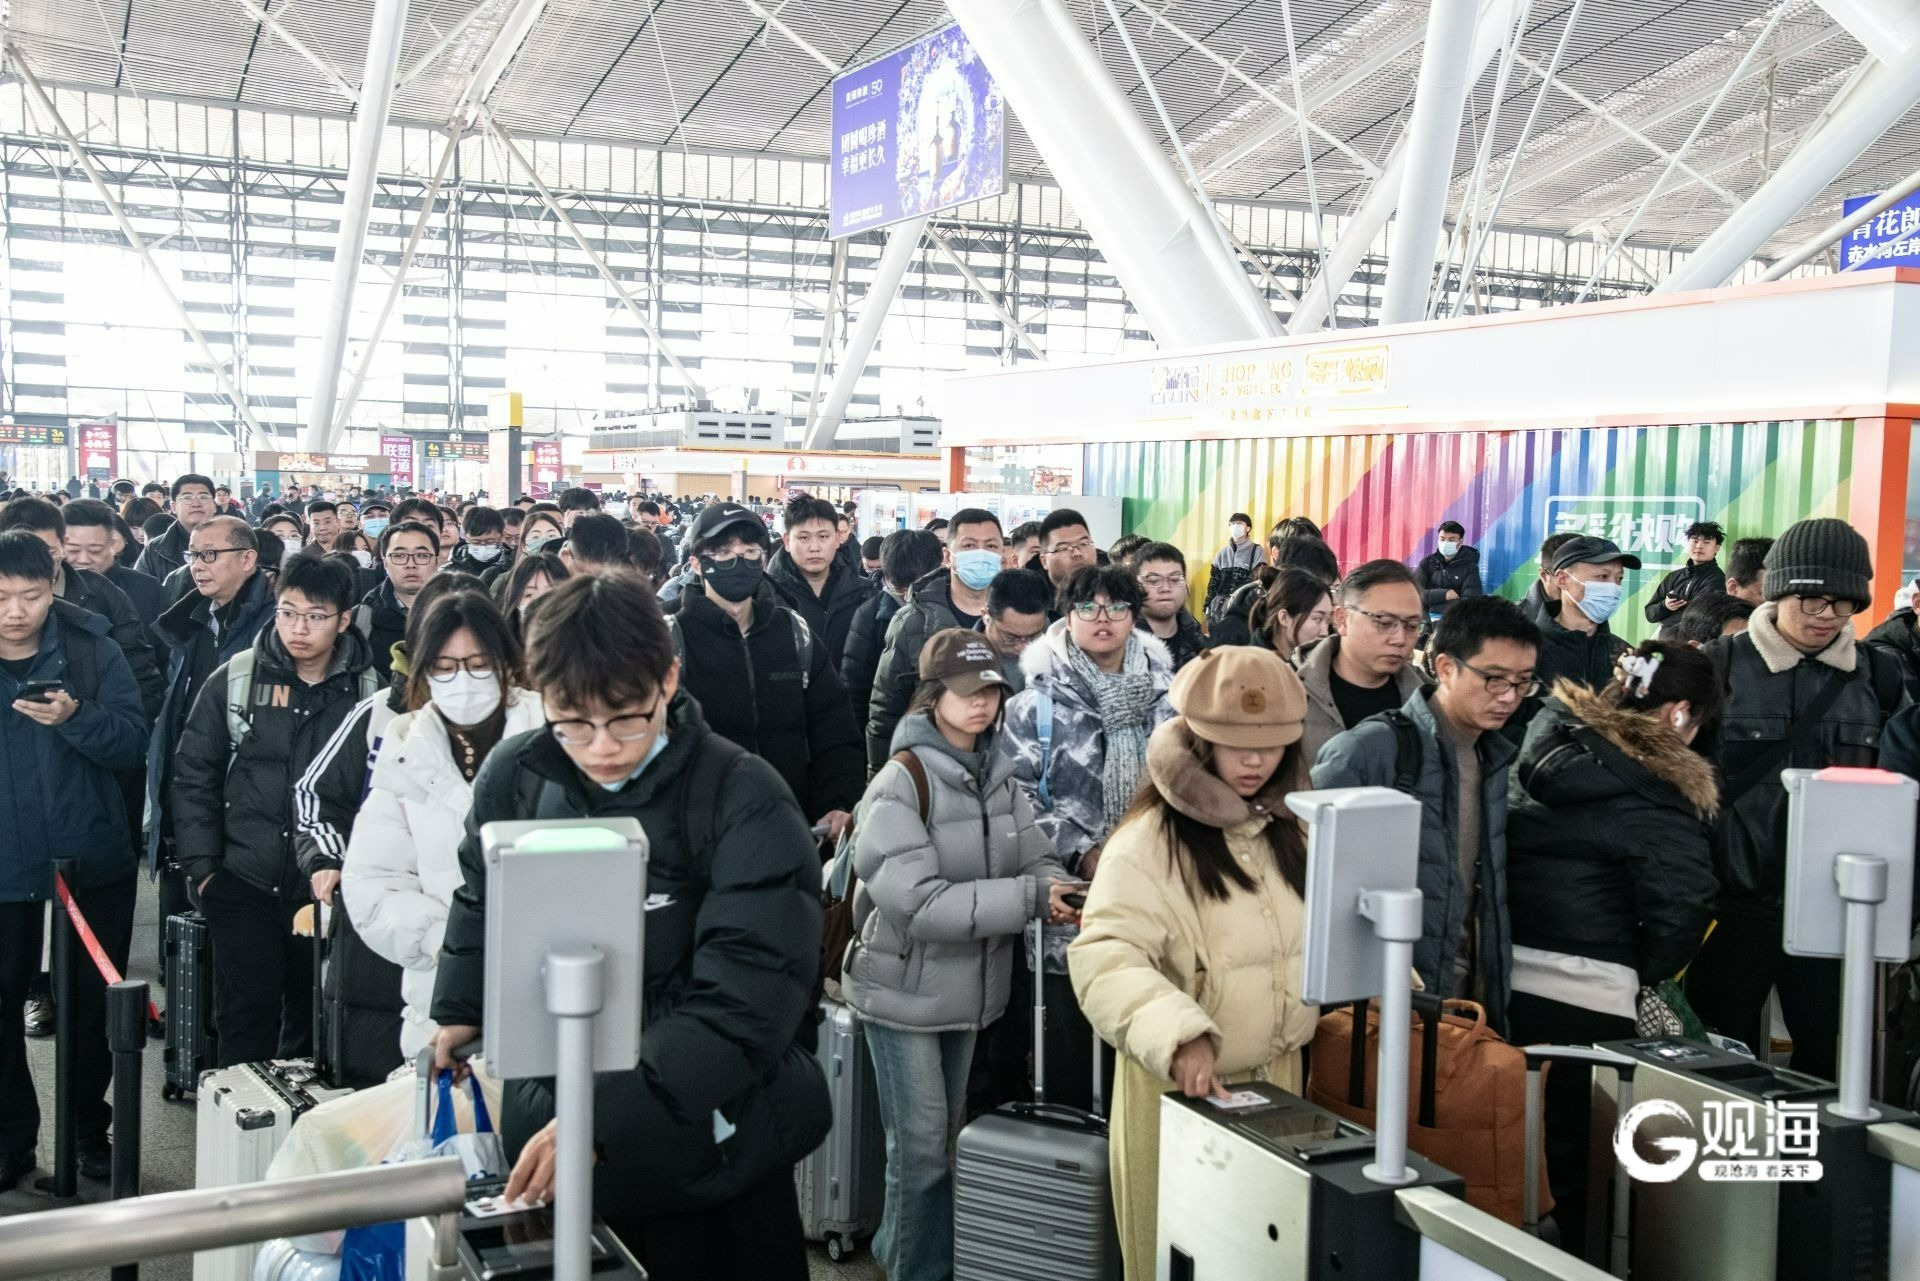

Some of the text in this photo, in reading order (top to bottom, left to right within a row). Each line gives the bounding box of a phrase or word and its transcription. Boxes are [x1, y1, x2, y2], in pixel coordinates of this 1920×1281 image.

[841, 145, 886, 177] 幸福更长久
[255, 684, 290, 707] UN
